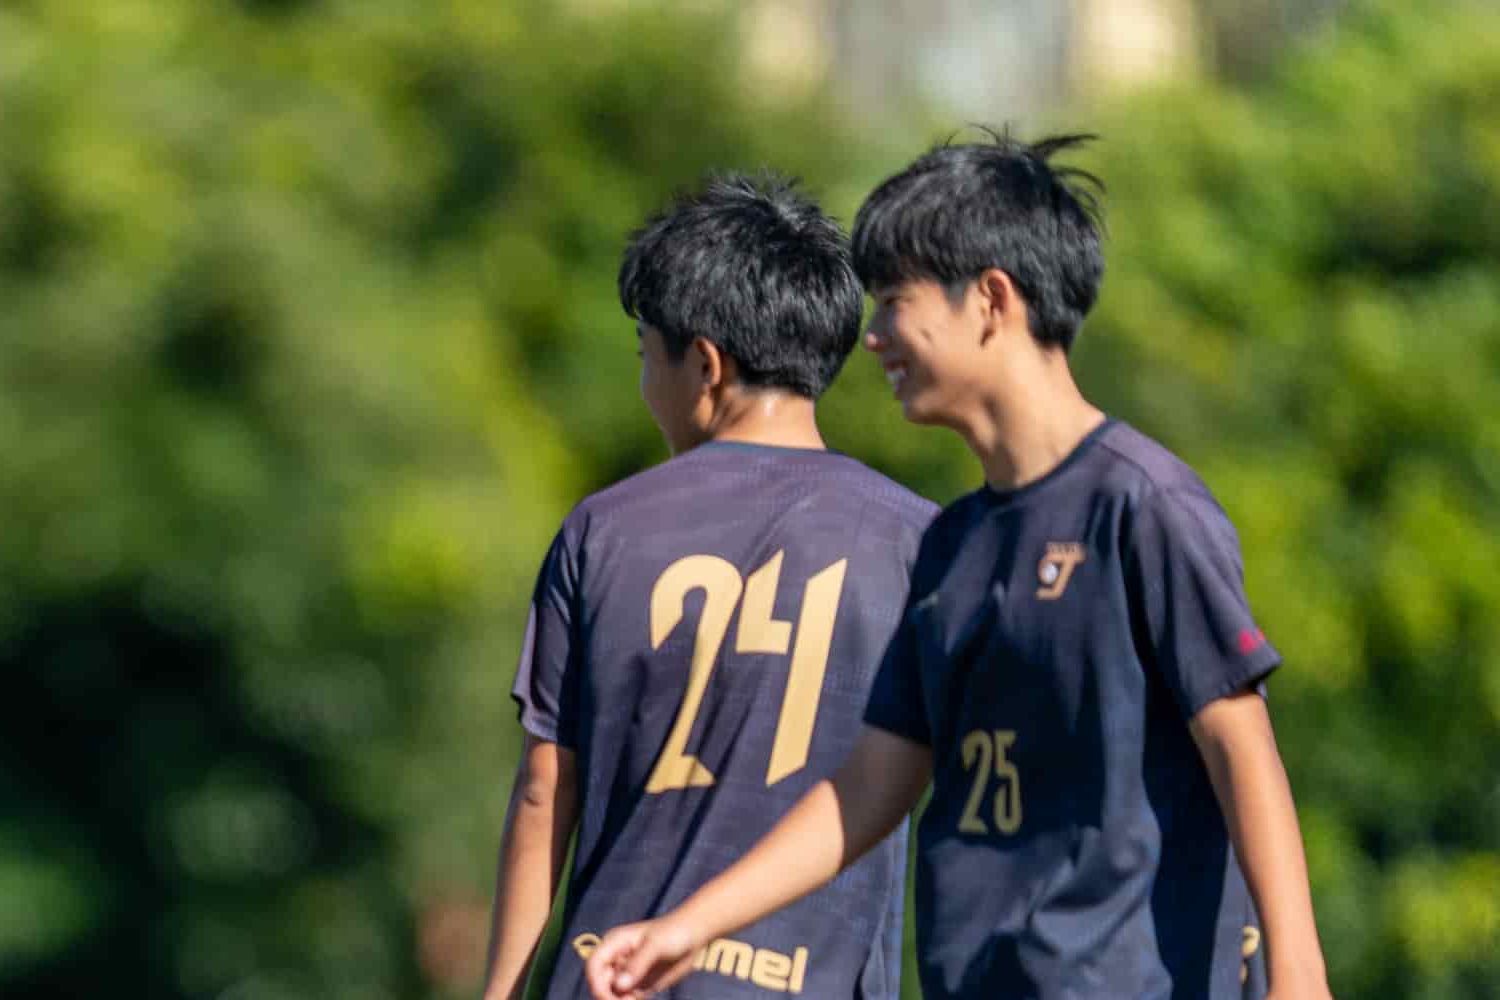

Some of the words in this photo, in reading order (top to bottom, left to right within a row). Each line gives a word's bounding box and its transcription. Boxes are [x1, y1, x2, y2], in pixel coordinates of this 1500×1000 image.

[645, 548, 847, 794] 24
[958, 729, 1022, 834] 25
[692, 938, 809, 994] mel
